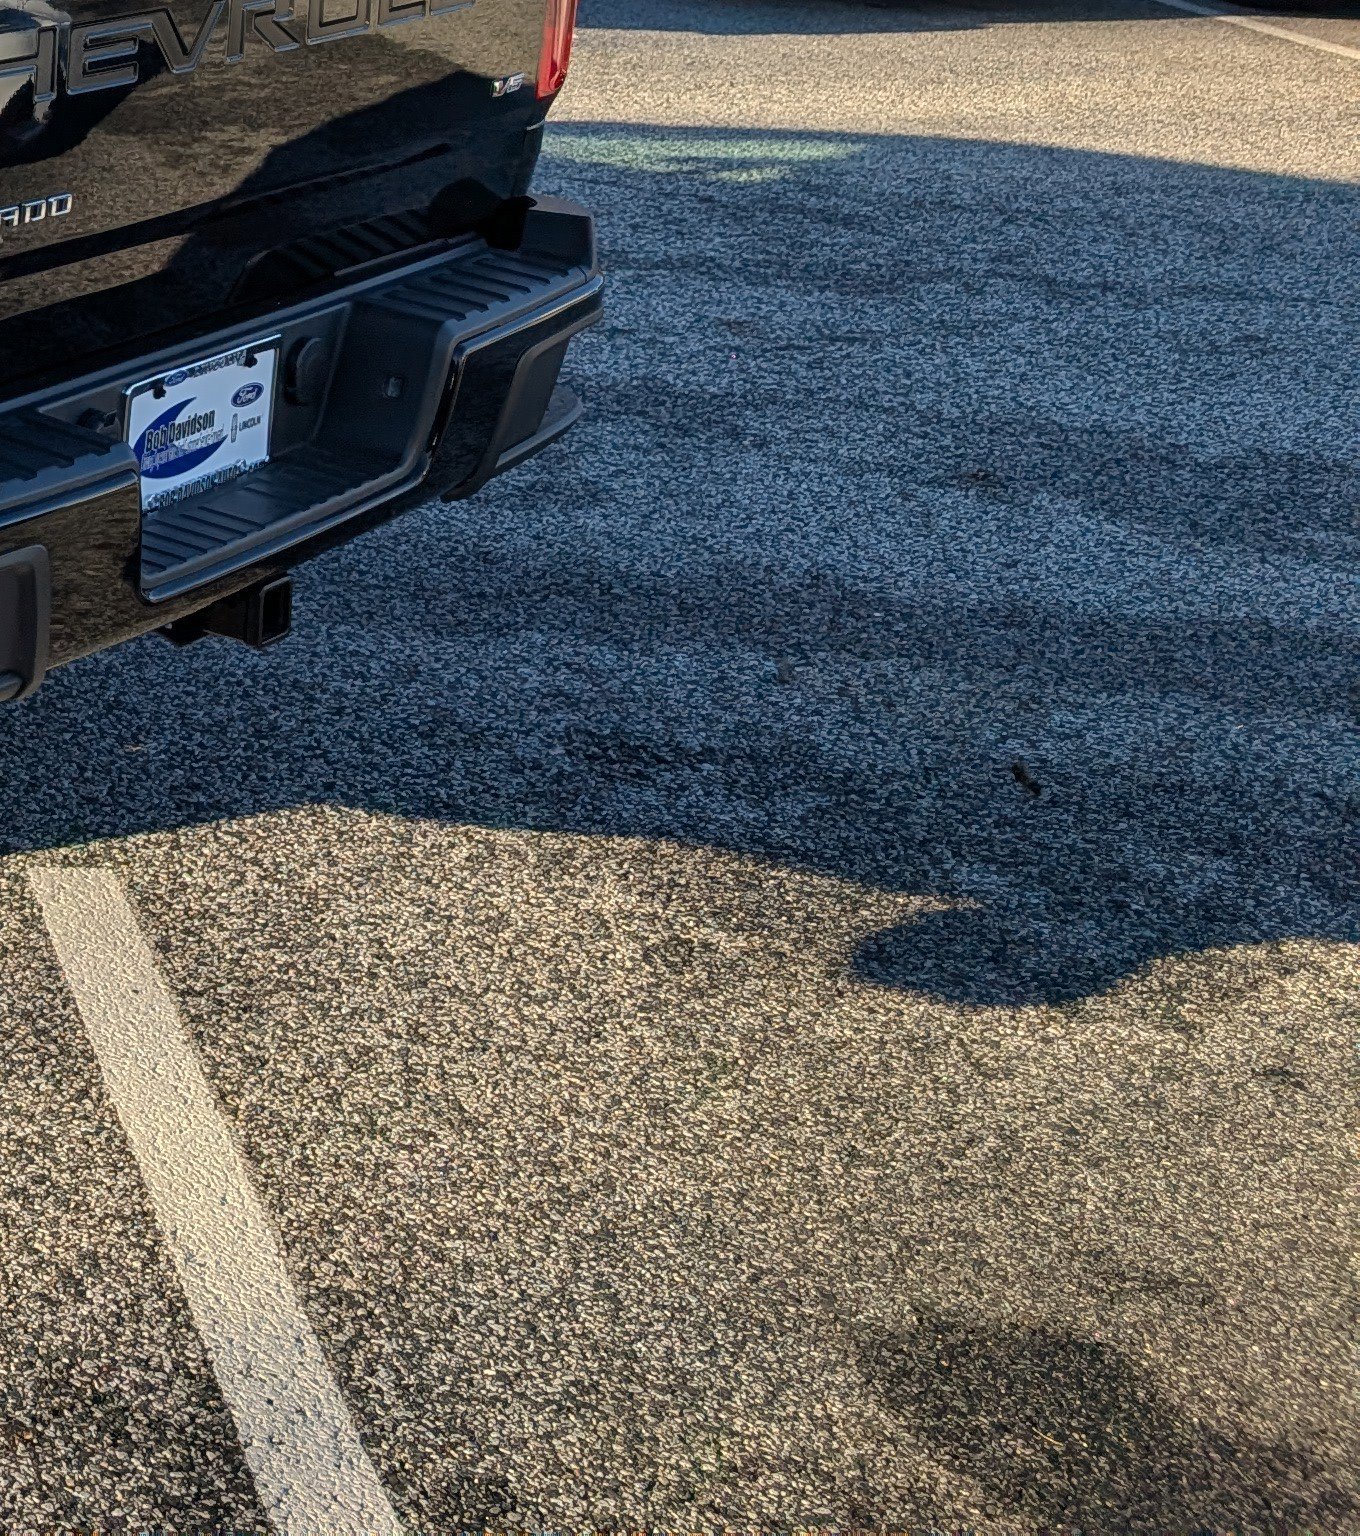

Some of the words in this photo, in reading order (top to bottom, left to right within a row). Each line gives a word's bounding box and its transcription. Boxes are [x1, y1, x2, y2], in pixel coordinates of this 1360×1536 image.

[491, 73, 525, 97] V6
[235, 385, 260, 405] Ford
[144, 425, 168, 453] Bob
[168, 410, 216, 443] Davidson
[239, 415, 262, 432] LINCOLN
